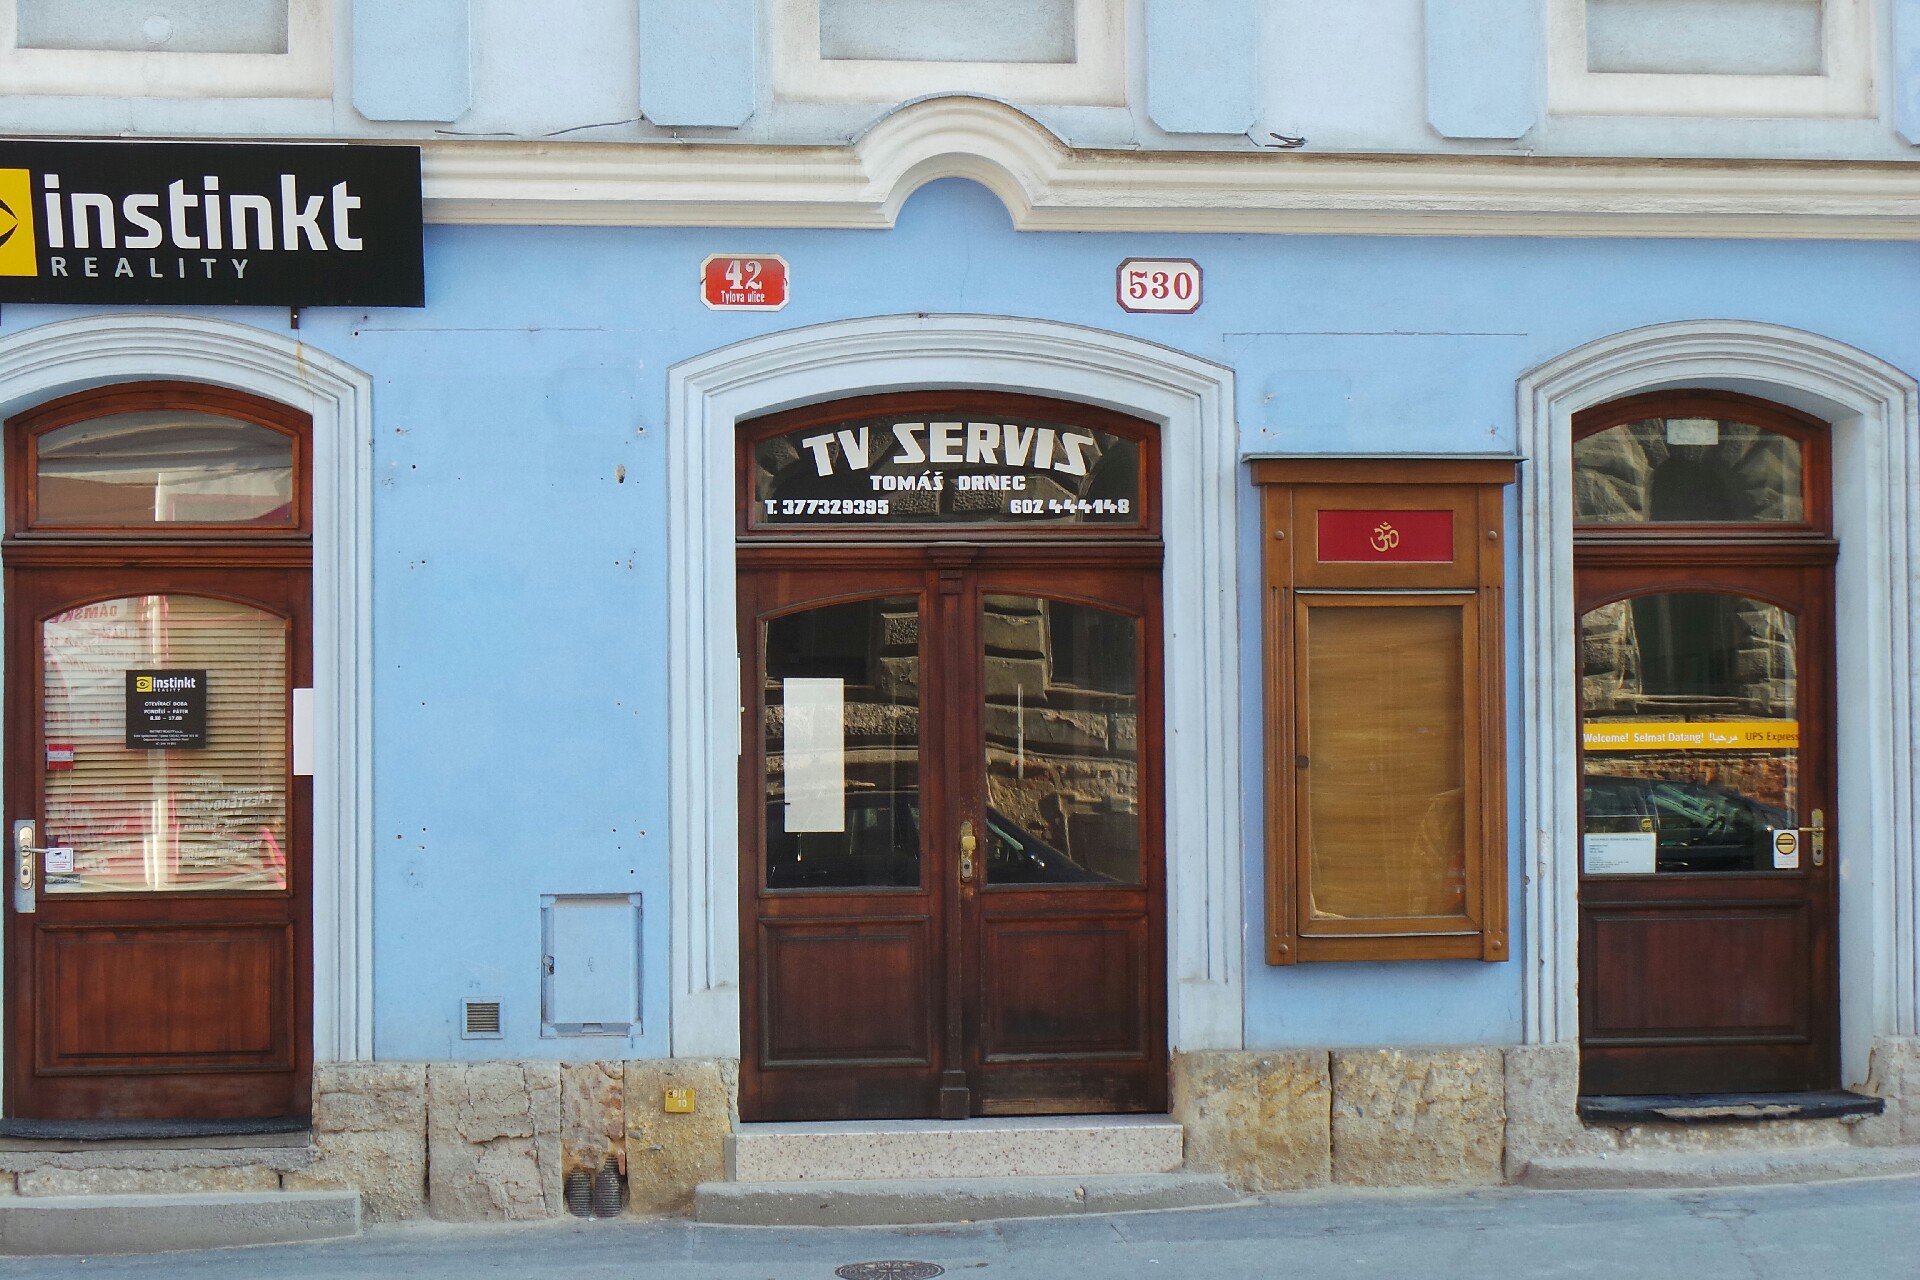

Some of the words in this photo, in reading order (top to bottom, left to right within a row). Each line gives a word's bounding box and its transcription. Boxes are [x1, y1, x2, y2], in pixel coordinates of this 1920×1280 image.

[44, 174, 363, 251] instinkt
[51, 256, 249, 279] REALITY
[725, 260, 762, 290] 42
[1129, 270, 1193, 300] 530
[720, 290, 745, 304] Tylova
[747, 290, 765, 303] ulice
[802, 426, 869, 477] TV
[892, 422, 1093, 476] SERVIS
[870, 469, 944, 491] TOMÁŠ
[958, 475, 1026, 491] DRNEC
[765, 500, 778, 514] T.
[782, 499, 889, 515] 377329395
[1010, 499, 1044, 514] 602
[1048, 498, 1130, 515] 444148
[153, 676, 196, 689] instinkt
[1583, 733, 1629, 743] Welcome!
[1633, 733, 1666, 743] Selmat
[1668, 733, 1704, 744] Datang!
[1745, 731, 1764, 741] UPS
